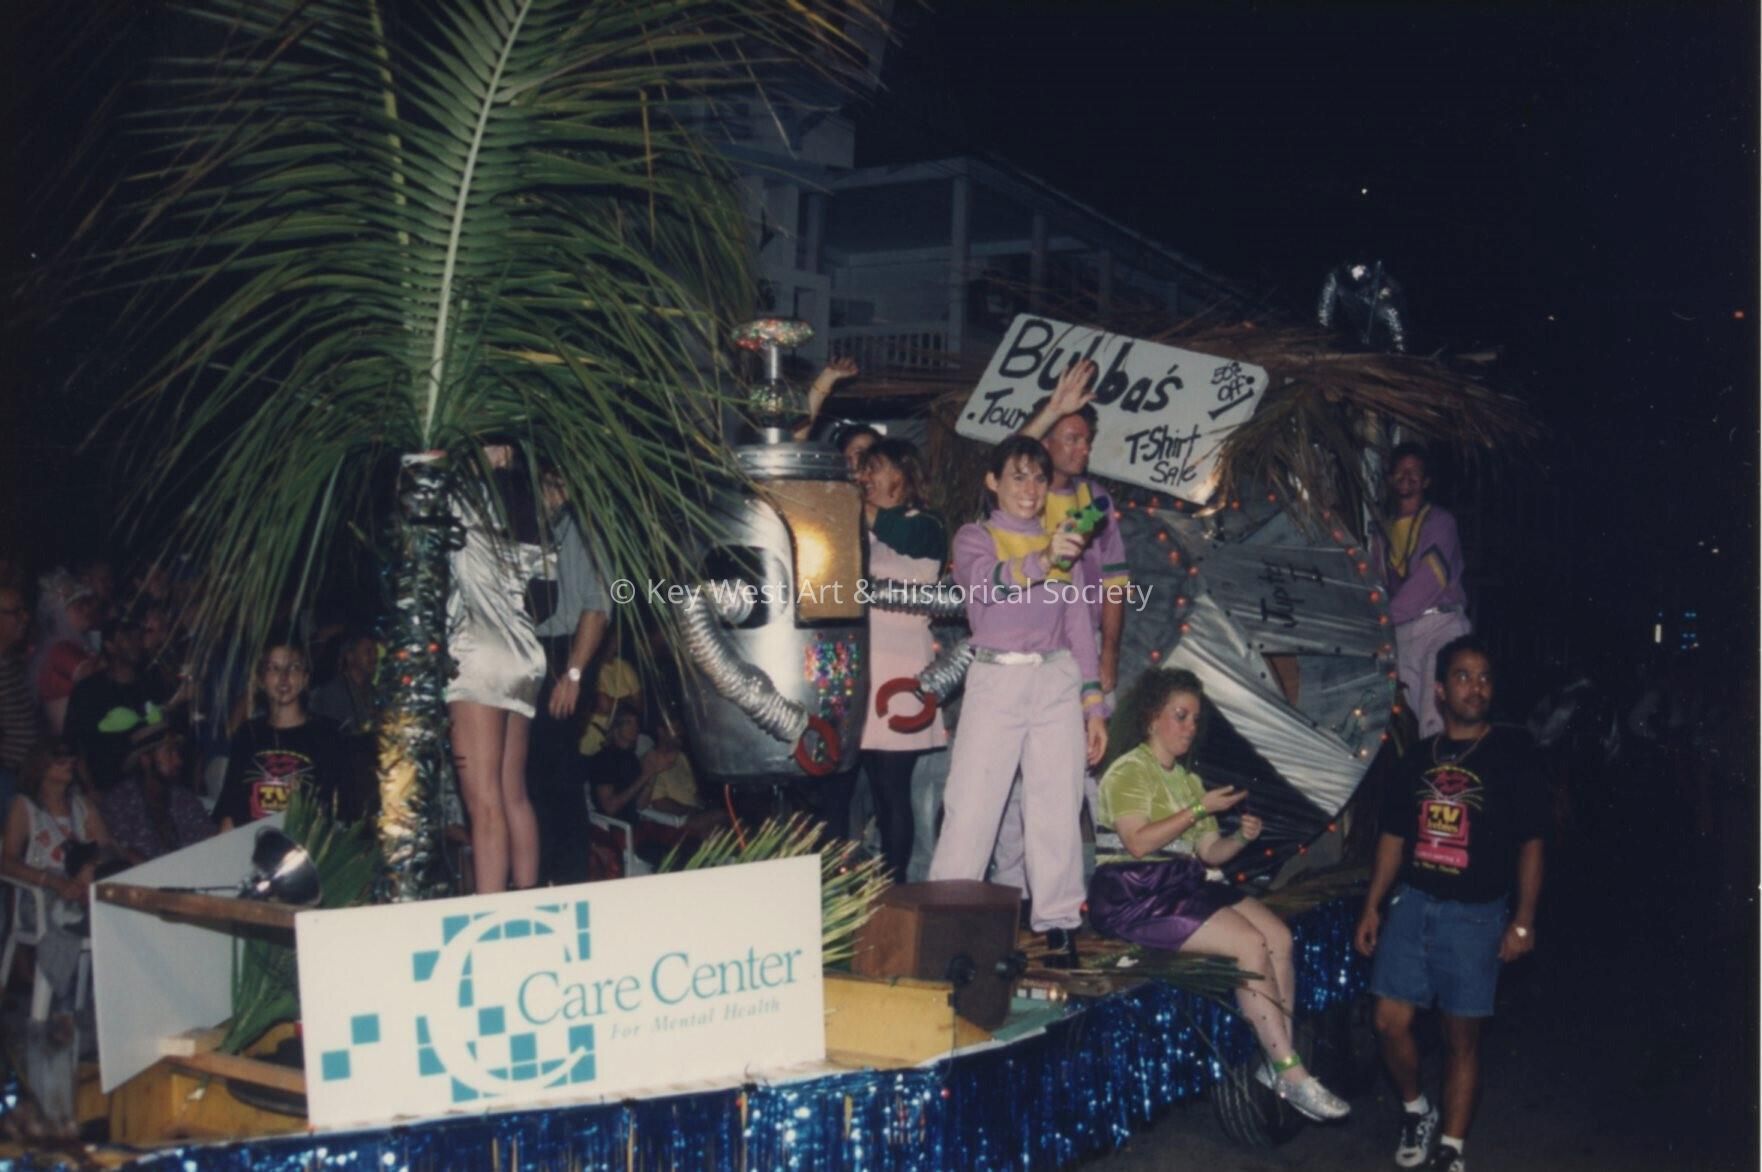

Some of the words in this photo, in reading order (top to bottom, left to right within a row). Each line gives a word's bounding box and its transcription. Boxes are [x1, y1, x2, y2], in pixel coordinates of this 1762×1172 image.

[1124, 424, 1202, 465] T-Shirt
[1429, 803, 1460, 823] TV
[517, 970, 641, 1026] Care
[651, 944, 803, 1006] Center
[610, 1022, 641, 1040] For
[653, 1007, 715, 1033] Mental
[723, 997, 781, 1021] Health
